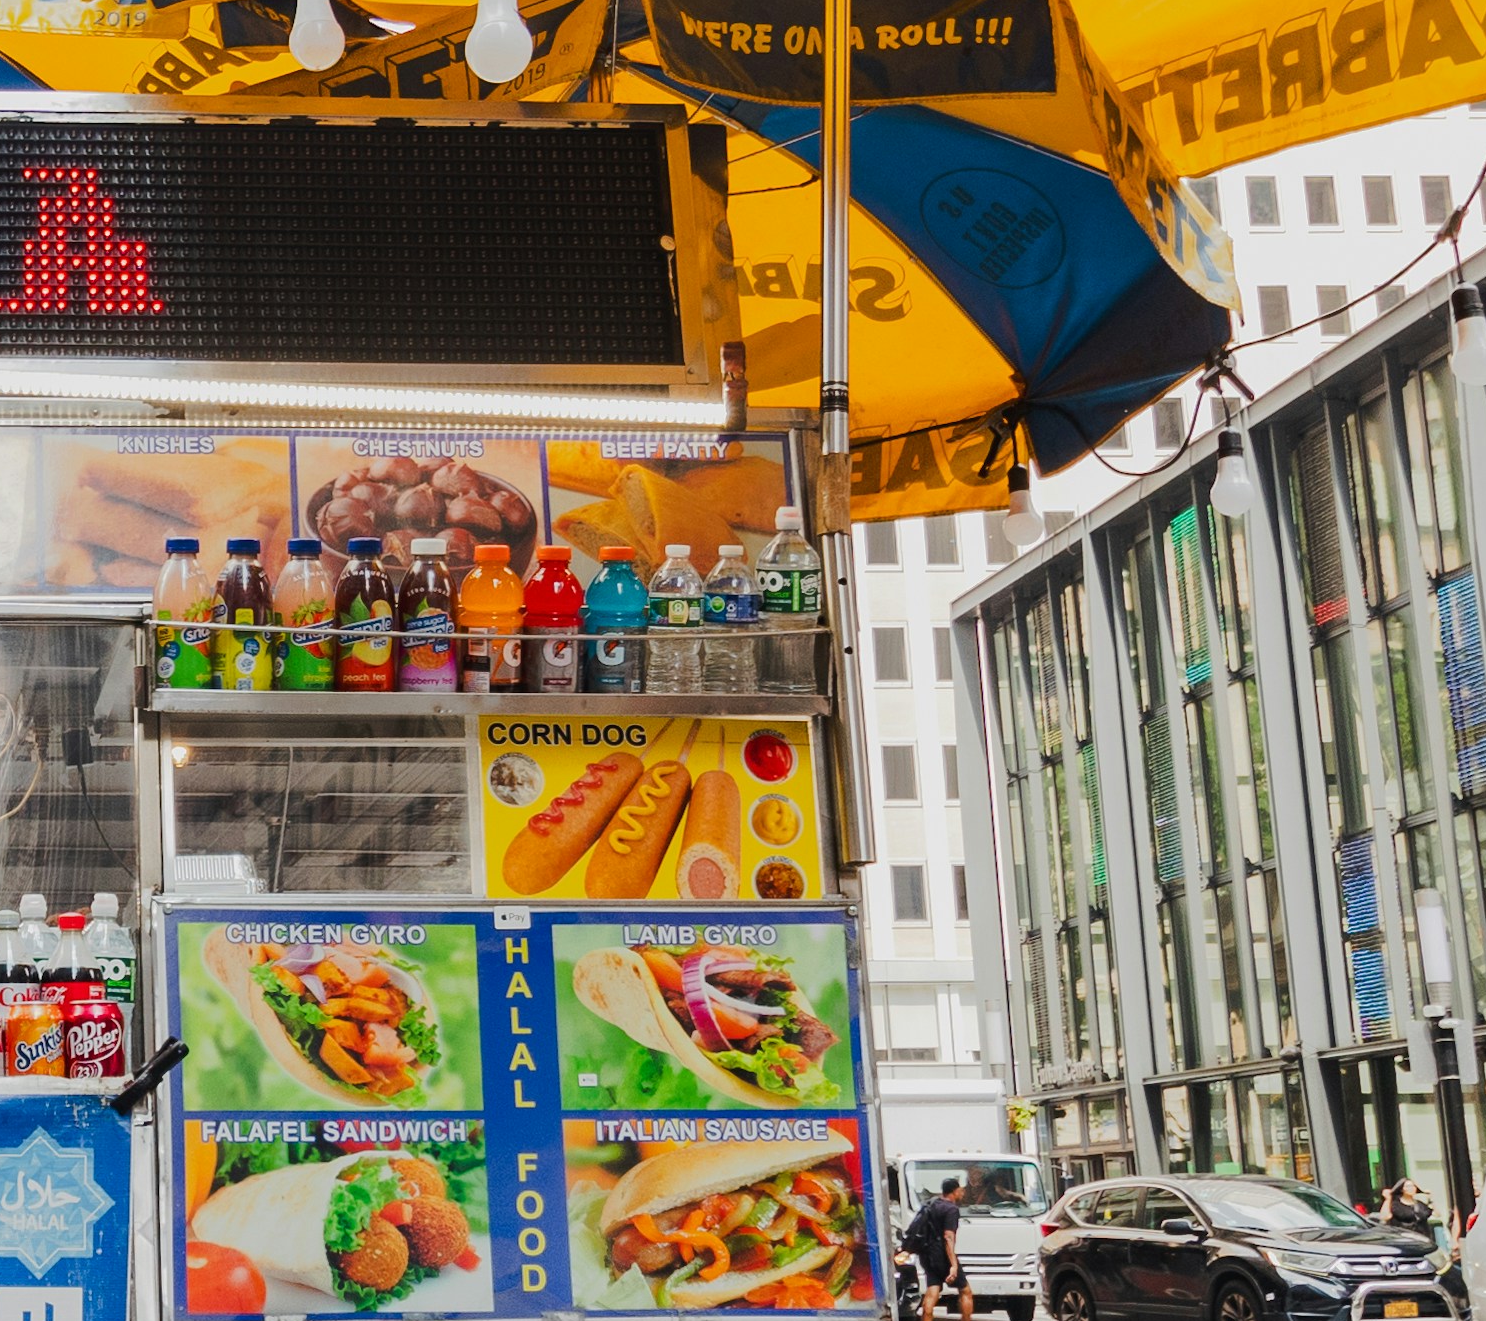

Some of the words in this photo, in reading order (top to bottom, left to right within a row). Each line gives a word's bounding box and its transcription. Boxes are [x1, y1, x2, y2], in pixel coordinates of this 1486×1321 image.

[93, 9, 147, 28] 2019
[681, 12, 774, 55] WE'RE
[873, 17, 963, 53] ROLL
[973, 16, 1013, 45] !!!
[117, 435, 216, 455] KNISHES
[352, 438, 485, 458] CHESTNUTS
[600, 440, 658, 461] BEEF
[660, 441, 730, 462] PATTY
[487, 722, 572, 746] CORN
[581, 723, 647, 747] DOG
[508, 912, 526, 923] Pay
[225, 922, 346, 946] CHICKEN
[350, 922, 426, 946] GYRO
[622, 924, 699, 947] LAMB
[703, 924, 778, 947] GYRO
[82, 1021, 107, 1039] Dr
[505, 936, 536, 1110] HALAL
[68, 1026, 119, 1059] Pepper
[201, 1120, 317, 1144] FALAFEL
[322, 1119, 468, 1144] SANDWICH
[595, 1119, 697, 1143] ITALIAN
[704, 1119, 829, 1142] SAUSAGE
[12, 1213, 70, 1232] HALAL
[515, 1152, 547, 1294] FOOD
